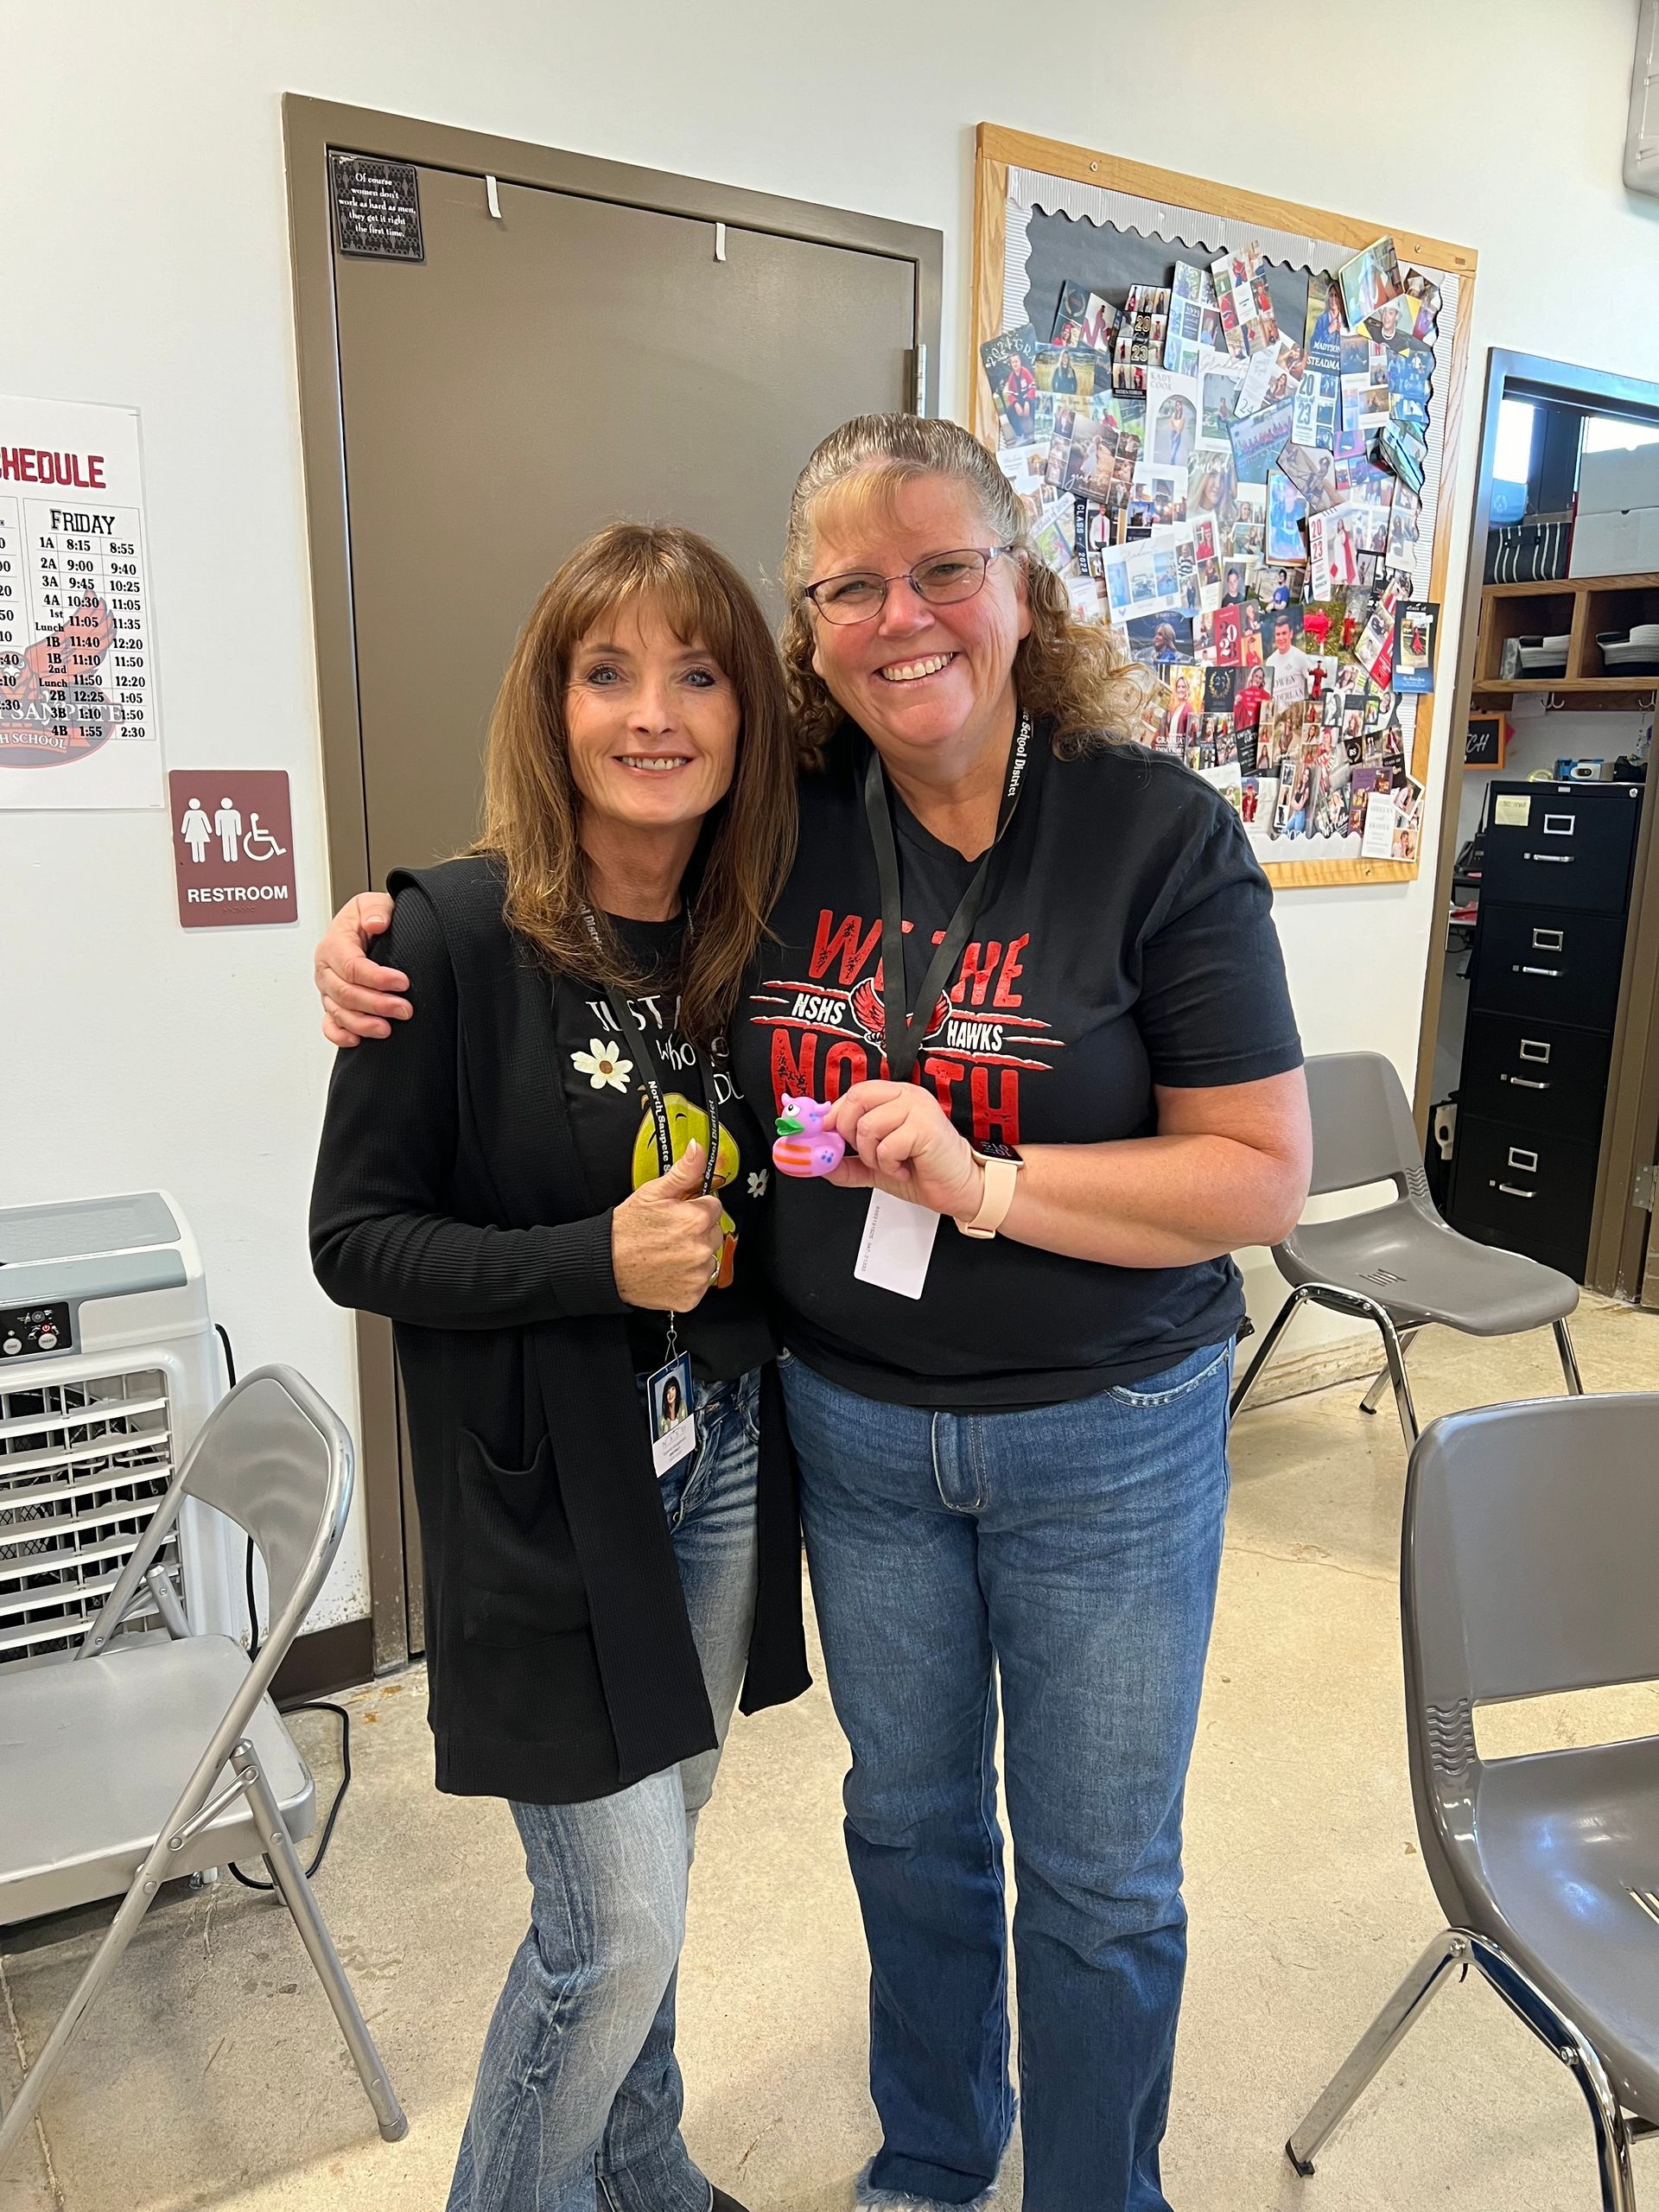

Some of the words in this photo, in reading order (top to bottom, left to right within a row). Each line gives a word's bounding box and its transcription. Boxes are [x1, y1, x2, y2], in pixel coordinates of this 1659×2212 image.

[355, 173, 366, 182] Of
[368, 177, 393, 186] course
[351, 188, 378, 196] women
[379, 188, 399, 199] don't
[338, 196, 358, 206] work
[369, 199, 387, 210] hard
[349, 209, 365, 221] they
[388, 215, 405, 225] right
[355, 223, 367, 232] the
[369, 224, 385, 234] first
[386, 229, 405, 237] time.
[50, 509, 115, 534] FRIDAY
[1076, 504, 1085, 534] CLASS
[39, 537, 54, 548] 1A
[67, 539, 91, 551] 8:15
[110, 542, 134, 554] 8:55
[1313, 540, 1323, 560] 23
[41, 558, 57, 569] 2A
[67, 560, 93, 572] 9:00
[111, 563, 136, 575] 9:40
[42, 576, 59, 587] 3A
[69, 578, 95, 590] 9:45
[110, 581, 140, 592] 10:25
[44, 594, 60, 606] 4A
[67, 596, 99, 608] 10:30
[112, 599, 141, 610] 11:05
[50, 609, 63, 618] 1st
[35, 622, 65, 632] Lunch
[69, 616, 99, 628] 11:05
[113, 618, 141, 630] 11:35
[46, 636, 60, 647] 1B
[70, 636, 100, 647] 11:40
[113, 638, 143, 649] 12:20
[48, 653, 62, 664] 1B
[73, 655, 101, 666] 11:10
[115, 656, 144, 667] 11:50
[48, 665, 67, 674] 2nd
[39, 678, 68, 688] Lunch
[73, 675, 102, 686] 11:50
[116, 676, 145, 687] 12:20
[50, 690, 66, 701] 2B
[74, 691, 104, 702] 12:25
[120, 693, 143, 703] 1:05
[51, 708, 67, 718] 3B
[79, 709, 101, 719] 1:10
[121, 710, 143, 720] 1:50
[51, 726, 68, 736] 4B
[79, 726, 102, 736] 1:55
[121, 728, 145, 737] 2:30
[1016, 721, 1031, 757] School
[13, 733, 67, 749] SCHOOL
[1007, 758, 1026, 797] District
[188, 885, 288, 903] RESTROOM
[791, 993, 846, 1025] NSHS
[947, 1020, 1004, 1052] HAWKS
[648, 1080, 663, 1117] North
[658, 1116, 669, 1162] Sanpete
[709, 1100, 718, 1141] District
[704, 1141, 717, 1180] School
